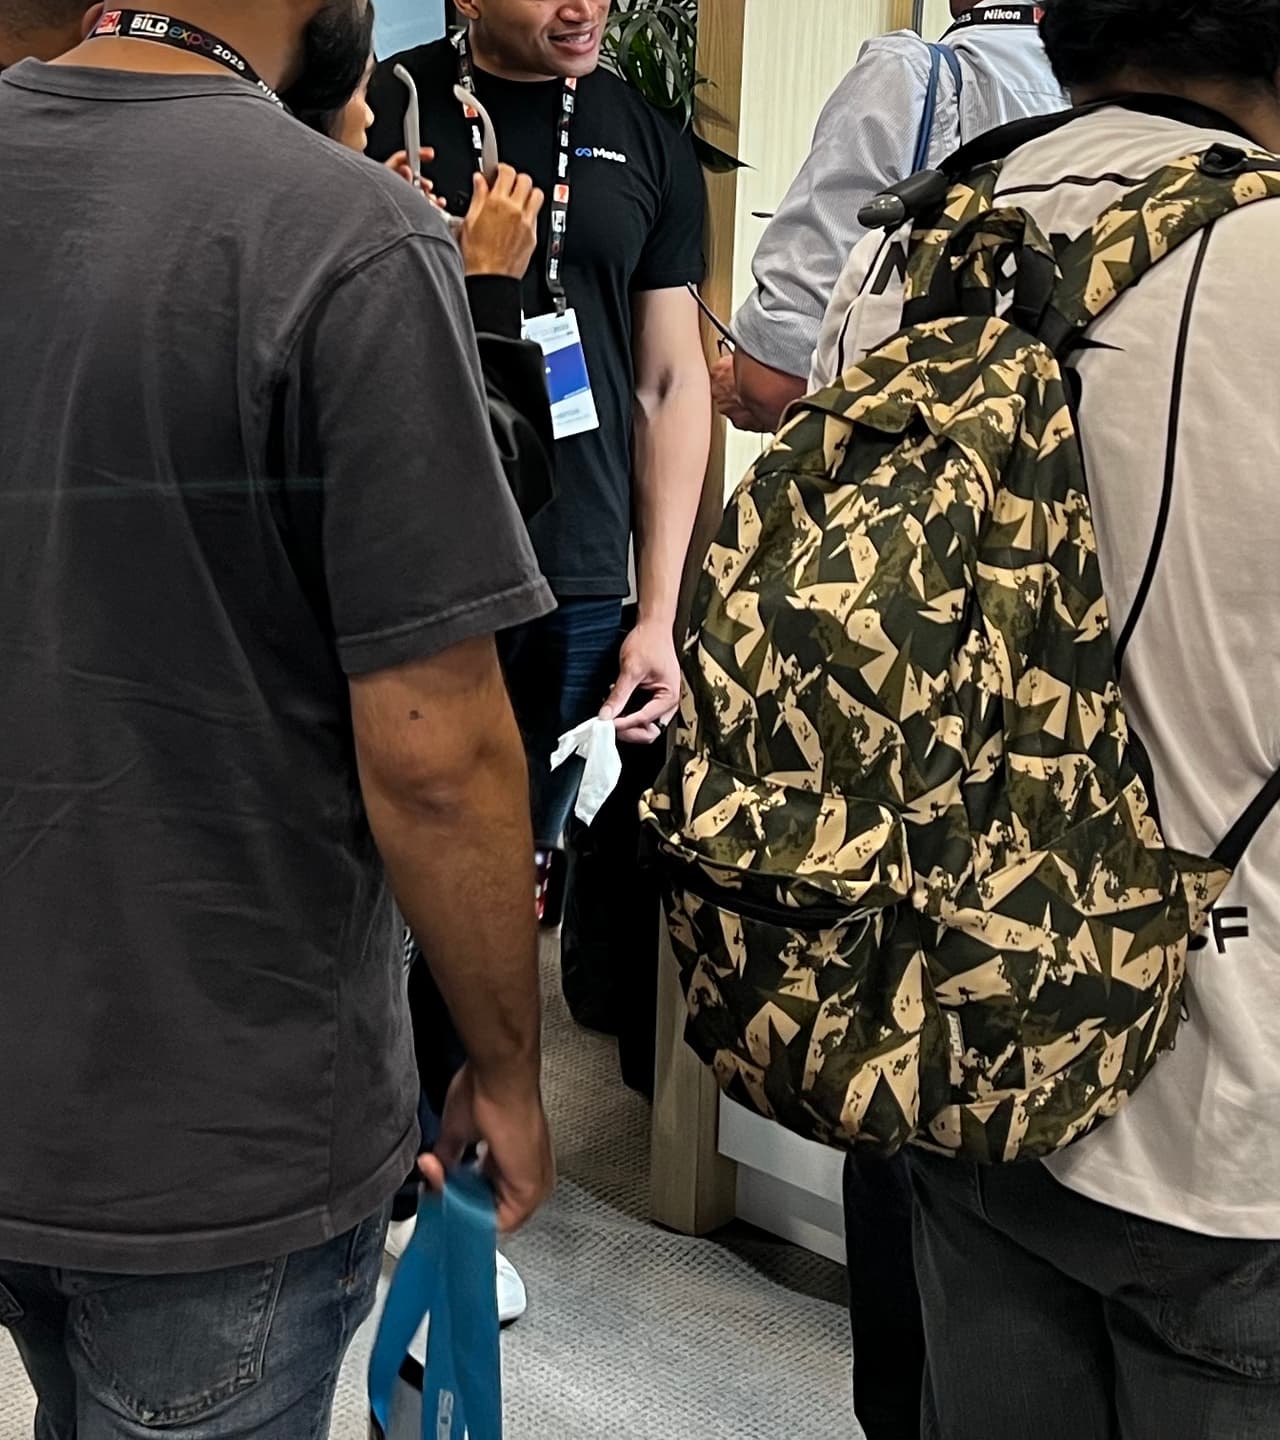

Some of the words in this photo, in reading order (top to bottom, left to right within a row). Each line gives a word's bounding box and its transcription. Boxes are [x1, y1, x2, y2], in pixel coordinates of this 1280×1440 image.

[983, 8, 1021, 21] Nikon
[213, 44, 245, 71] 2025
[592, 147, 627, 163] Meta
